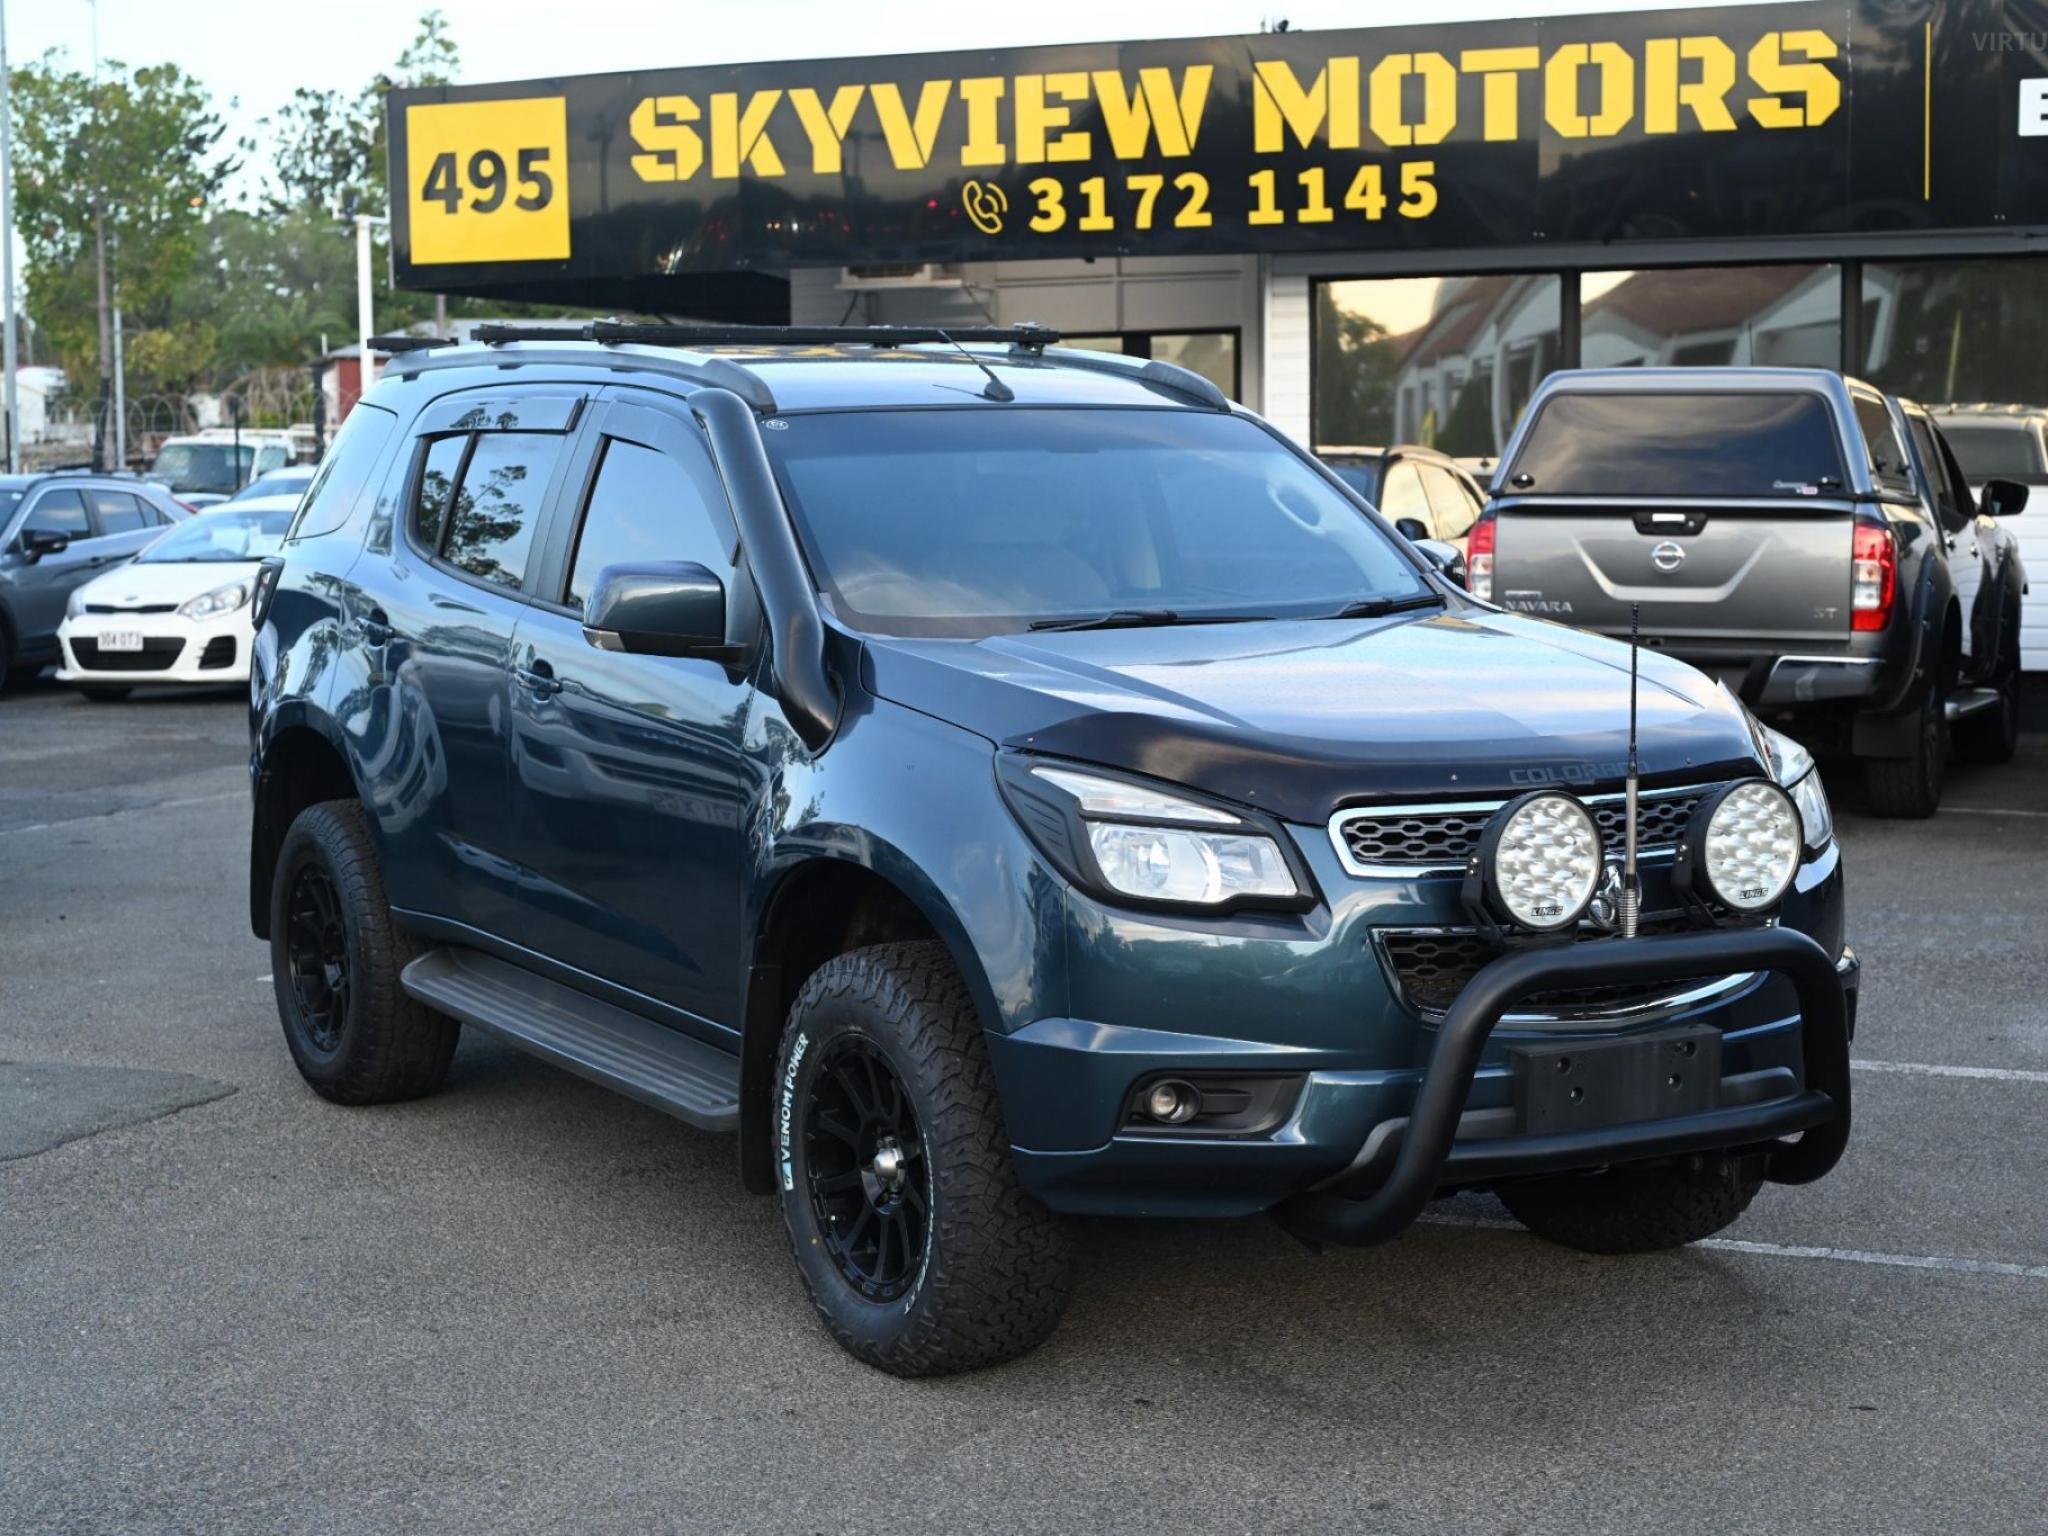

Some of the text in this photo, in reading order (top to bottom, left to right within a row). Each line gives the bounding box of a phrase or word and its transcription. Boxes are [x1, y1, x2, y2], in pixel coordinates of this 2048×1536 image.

[631, 30, 1842, 184] SKYVIEW MOTORS
[422, 148, 553, 214] 495
[1028, 159, 1439, 234] 3172 1145
[1504, 600, 1574, 613] NAVARA
[780, 1032, 809, 1162] VENOM POWER
